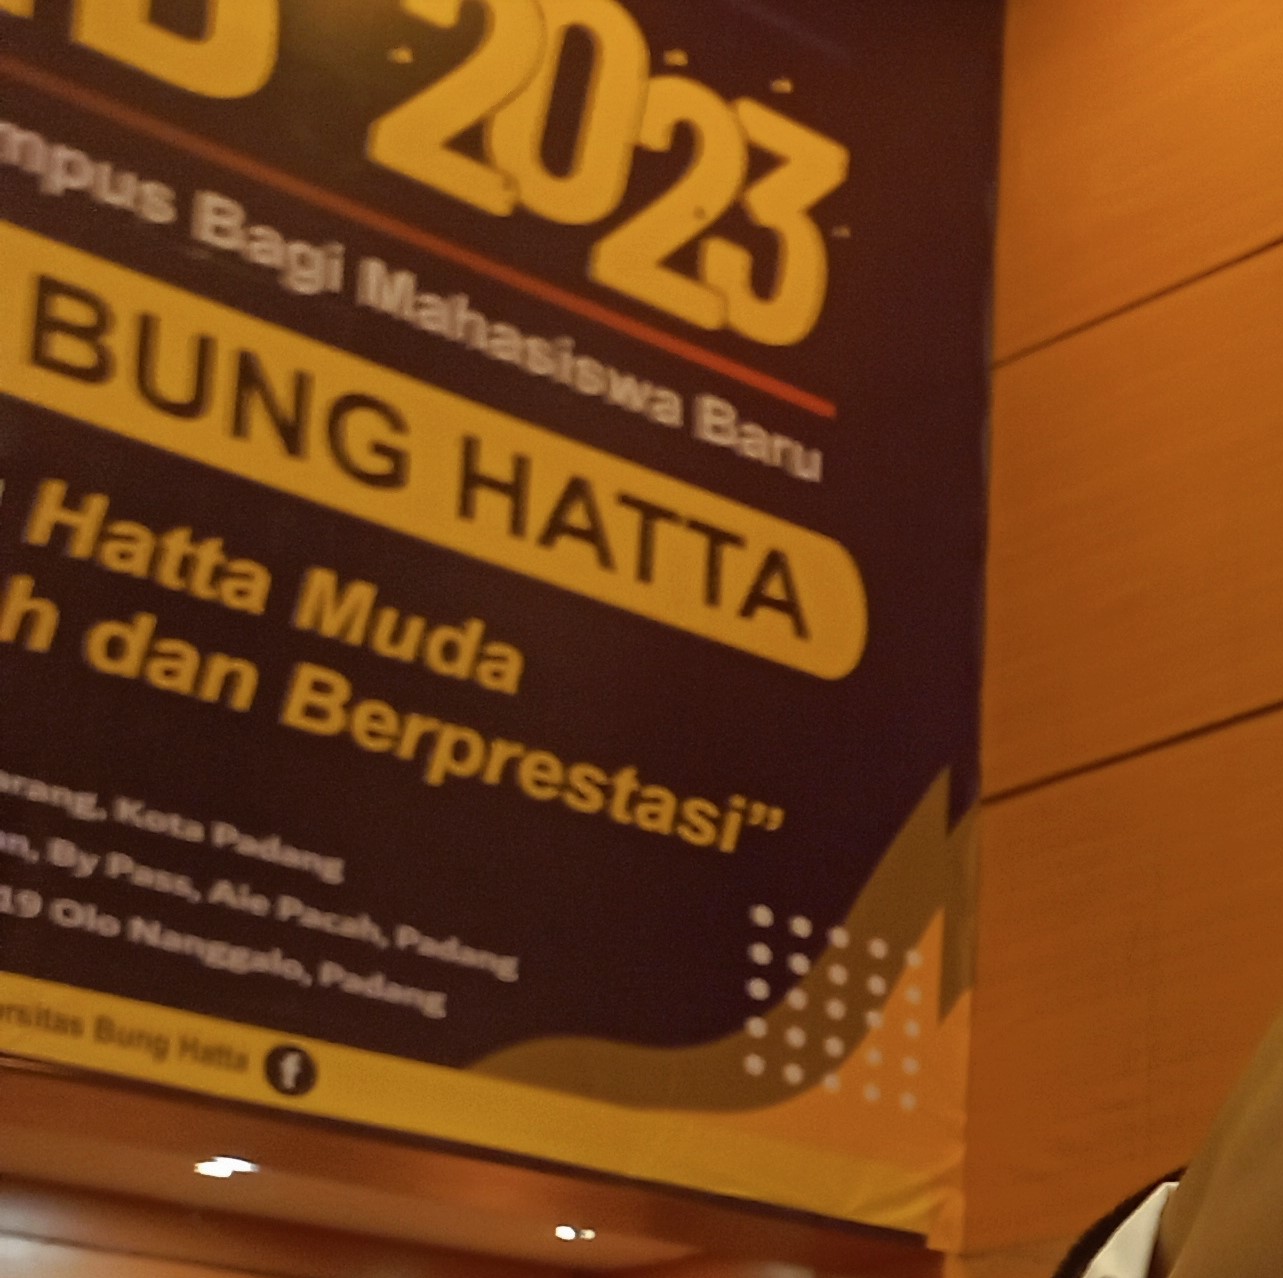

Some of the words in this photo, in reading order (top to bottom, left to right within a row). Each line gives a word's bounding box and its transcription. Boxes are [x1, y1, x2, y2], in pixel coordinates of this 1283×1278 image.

[366, 0, 851, 347] 2023
[190, 190, 345, 295] Bagi
[356, 256, 684, 428] Mahasiswa
[692, 394, 824, 483] Baru
[29, 273, 411, 491] BUNG
[455, 435, 813, 641] HATTA
[23, 477, 273, 616] Hatta
[293, 566, 526, 695] Muda
[84, 611, 260, 712] dan
[46, 836, 100, 879] By
[104, 851, 202, 904] Pass,
[395, 924, 520, 982] Padang
[112, 795, 206, 843] Kota
[210, 820, 346, 886] Padang
[49, 898, 121, 938] Olo
[317, 960, 447, 1020] Padang
[93, 1014, 171, 1065] Bung
[178, 1031, 250, 1073] Hatta
